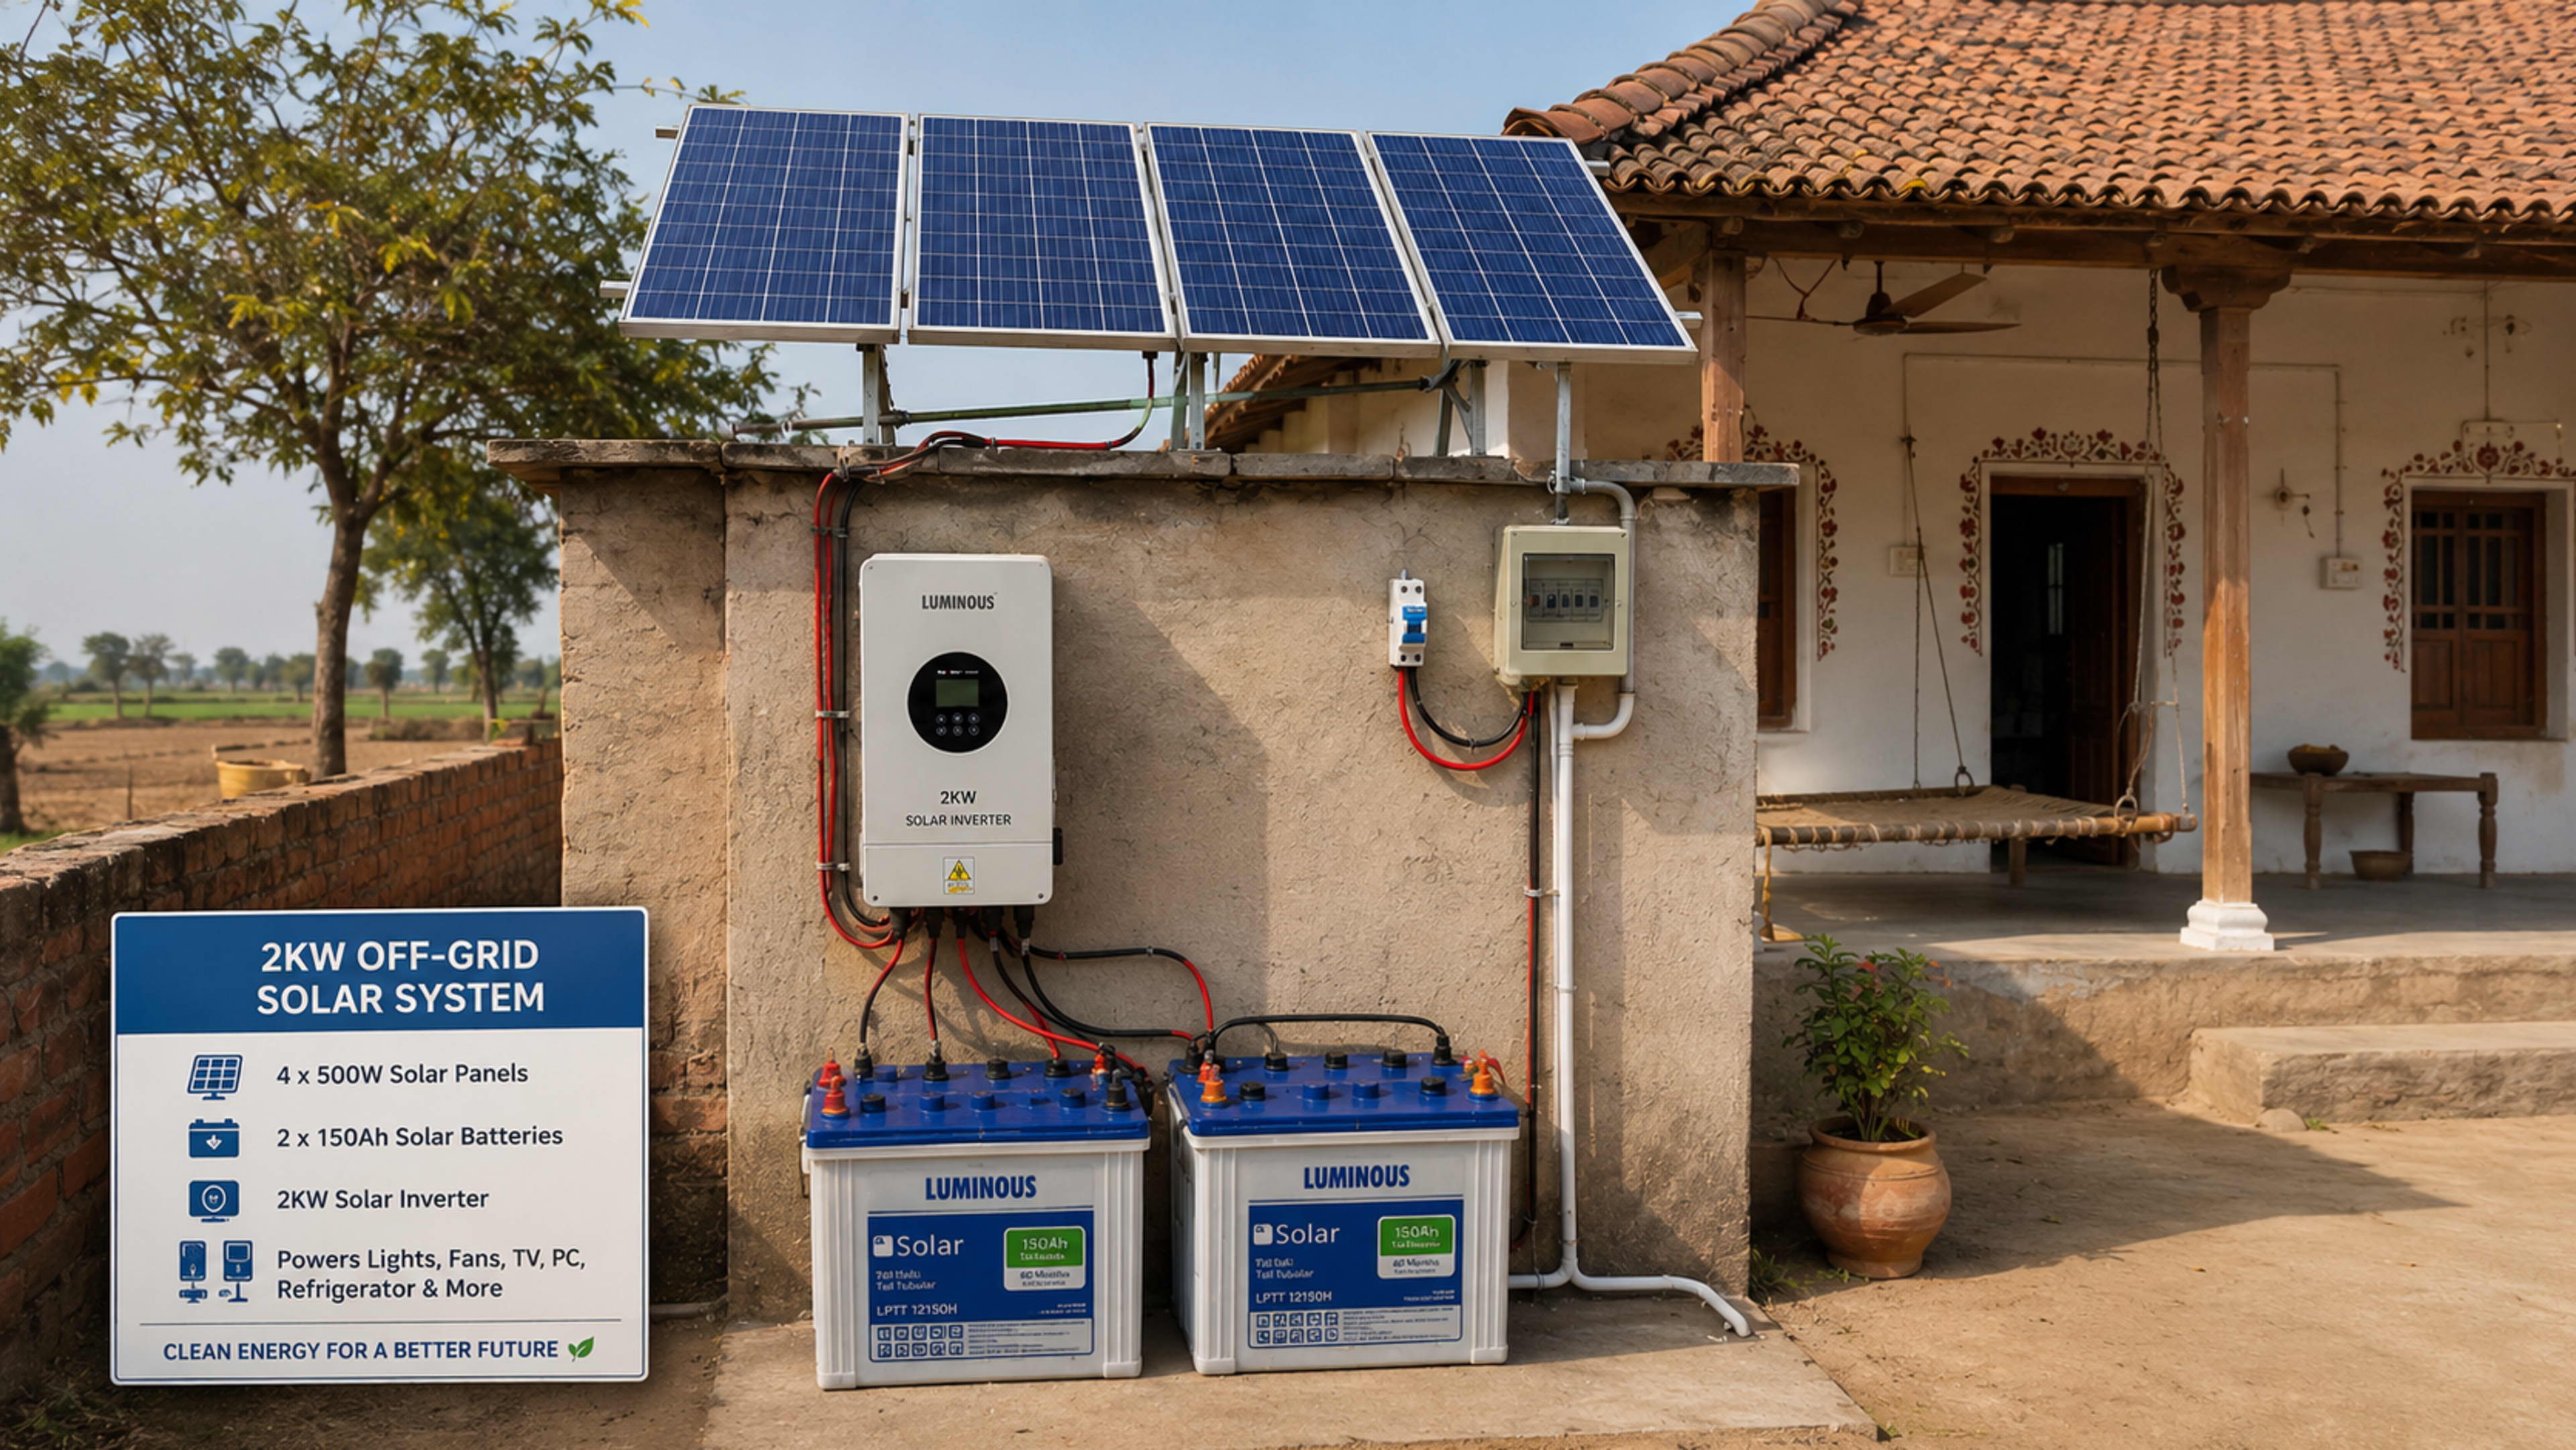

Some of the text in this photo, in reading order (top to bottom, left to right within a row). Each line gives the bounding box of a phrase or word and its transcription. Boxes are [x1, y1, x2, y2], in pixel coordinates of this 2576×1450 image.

[921, 594, 994, 610] LUMINOUS
[940, 790, 976, 805] 2KW
[905, 814, 1011, 827] SOLAR INVERTER
[261, 939, 538, 972] 2KW OFF-GRID
[256, 982, 543, 1015] SOLAR SYSTEM
[276, 1062, 528, 1085] 4 x 500W Solar Panels
[276, 1125, 563, 1147] 2 x 150Ah Solar Batteries
[924, 1175, 1036, 1200] LUMINOUS
[1303, 1164, 1409, 1190] LUMINOUS
[276, 1189, 488, 1209] 2KW Solar Inverter
[1275, 1223, 1340, 1245] Solar
[896, 1234, 963, 1257] Solar
[277, 1248, 584, 1274] Powers Lights, Fans, TV, PC,
[277, 1278, 502, 1304] Refrigerator & More
[1255, 1292, 1285, 1304] LPTT
[876, 1304, 907, 1316] LPTT
[162, 1340, 558, 1361] CLEAN ENERGY FOR A BETTER FUTURE
